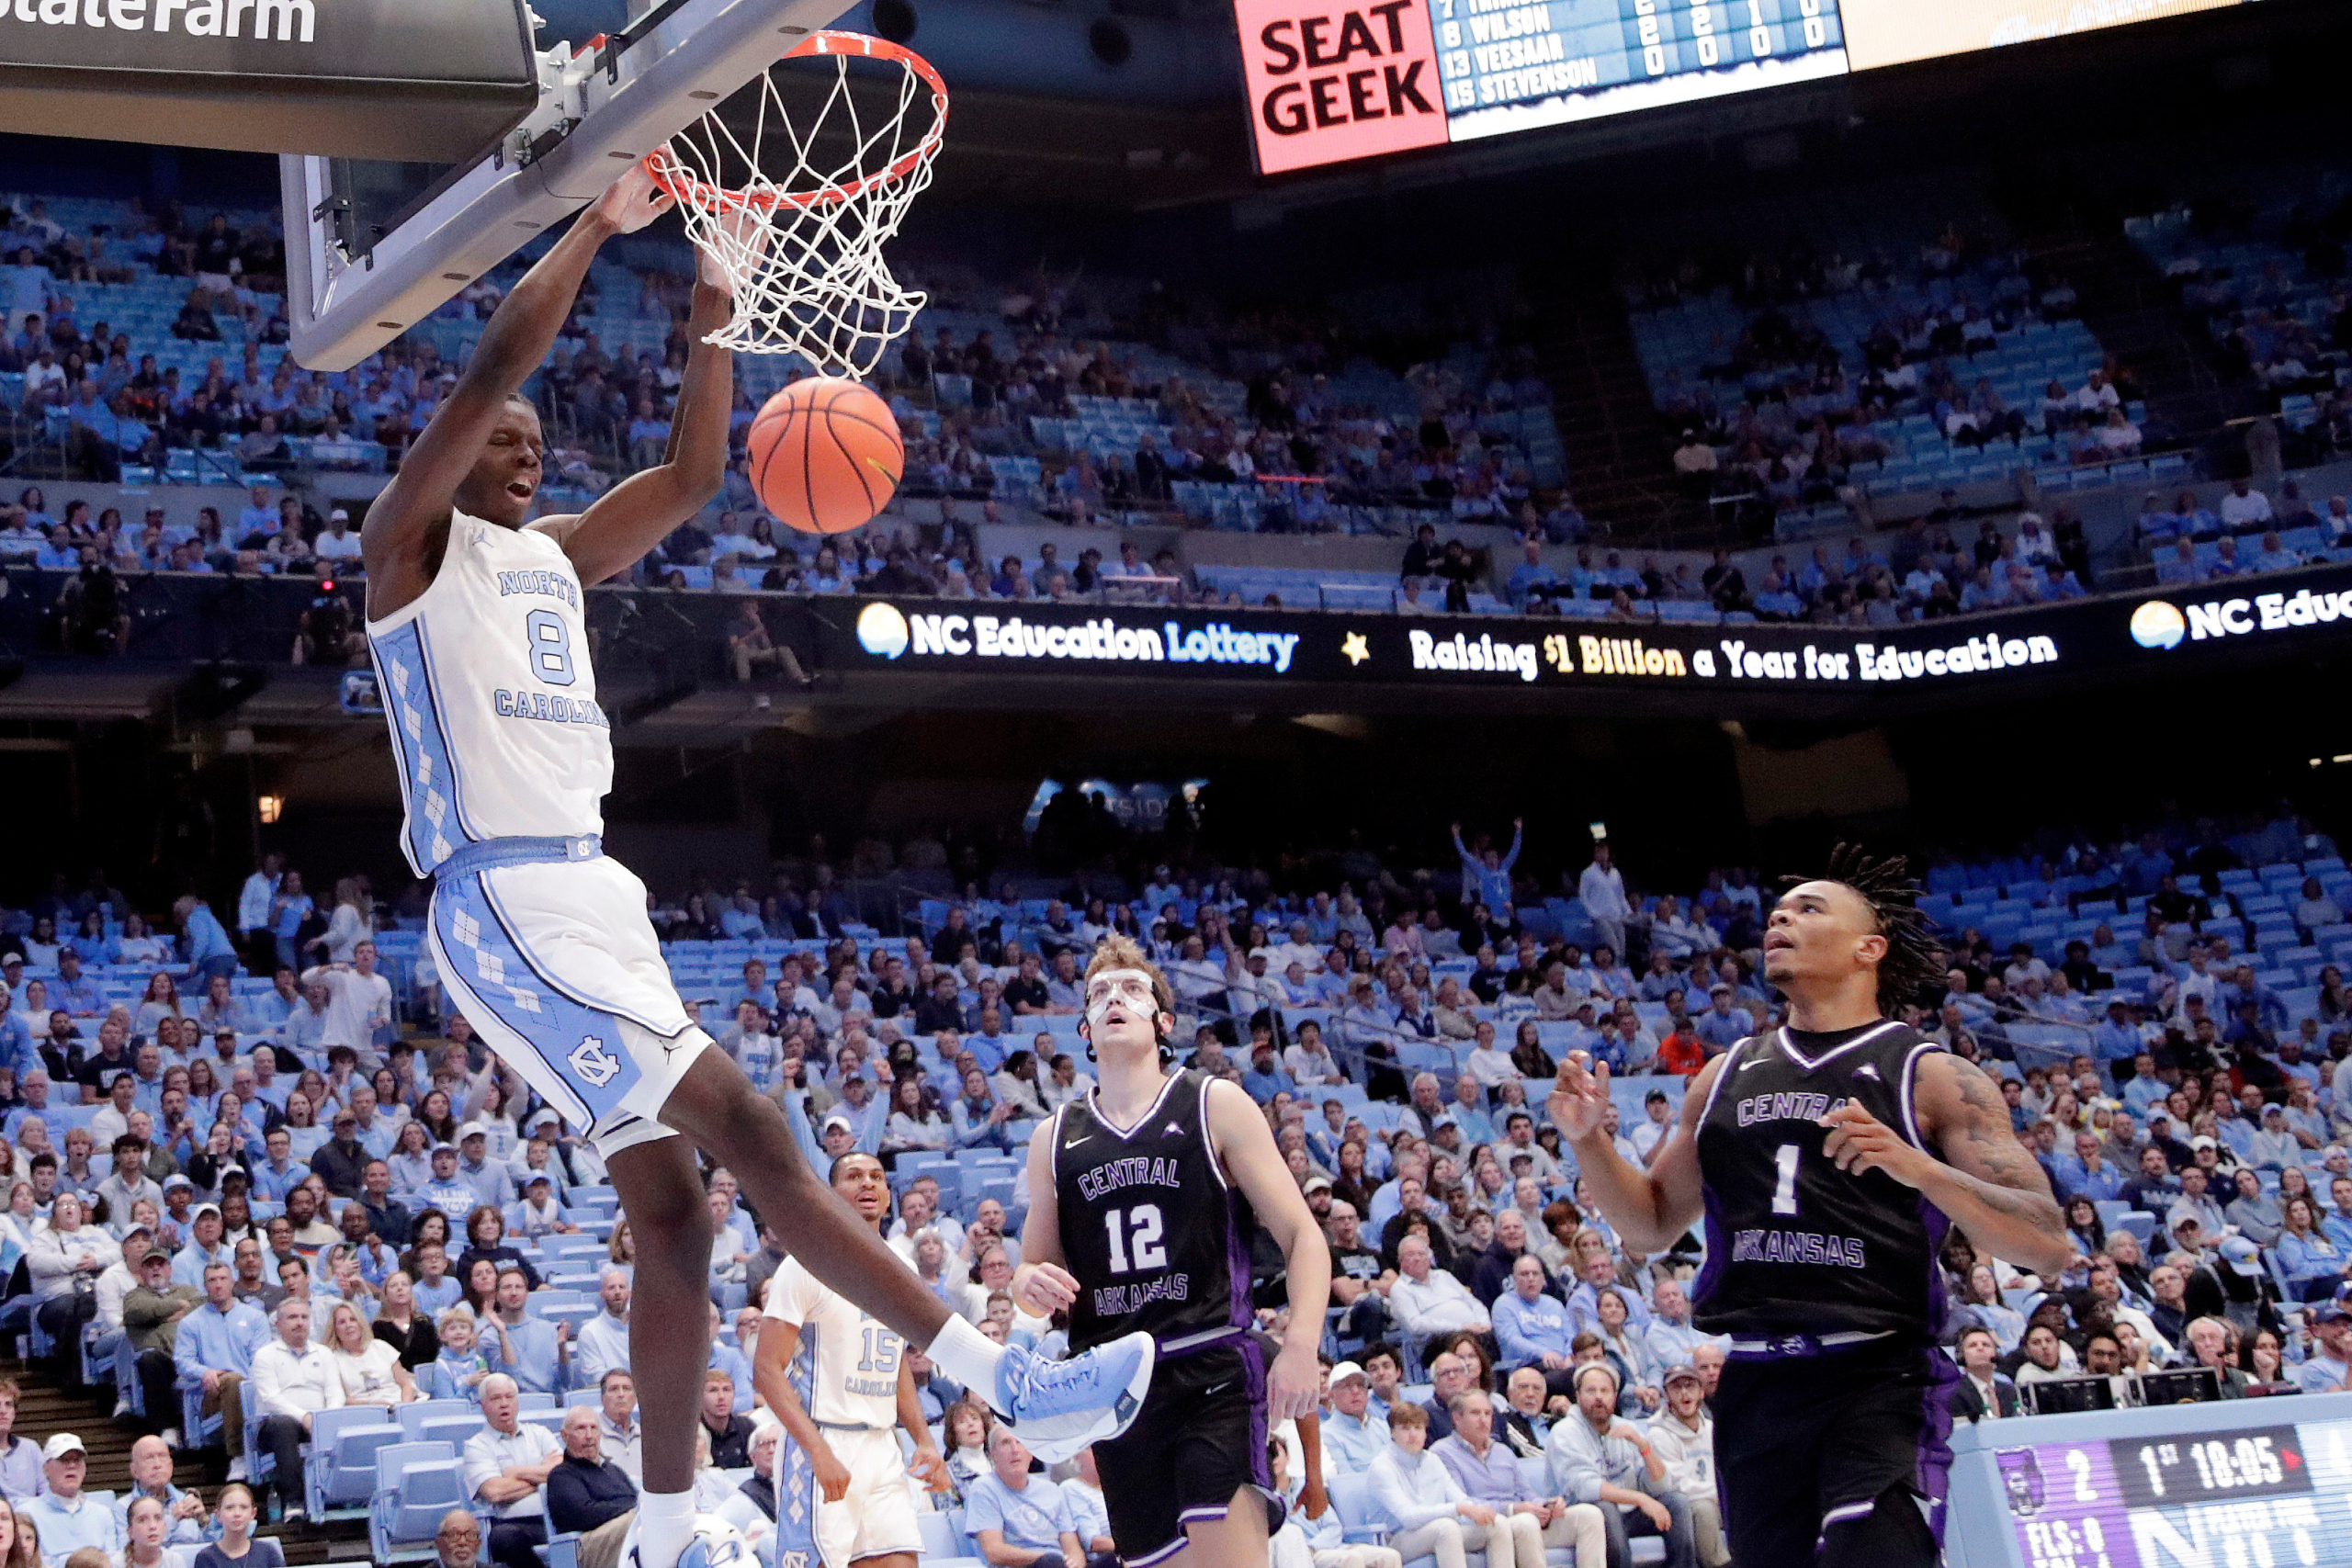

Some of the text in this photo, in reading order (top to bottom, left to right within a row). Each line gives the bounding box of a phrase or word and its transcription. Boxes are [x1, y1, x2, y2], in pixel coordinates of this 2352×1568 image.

[1261, 0, 1413, 75] SEAT
[1442, 20, 1462, 48] 8
[1470, 4, 1551, 44] WILSON
[1443, 50, 1471, 79] 13
[1474, 32, 1565, 73] VEESAAR
[1638, 15, 1660, 46] 2
[1690, 5, 1713, 37] 2
[1448, 16, 1826, 108] 15 STEVENSON 0 0 0 0
[1262, 60, 1438, 136] GEEK
[497, 570, 579, 610] NORTH
[2185, 598, 2256, 640] NC
[526, 608, 576, 686] 8
[909, 614, 1300, 673] NC Education Lottery
[1409, 629, 2058, 682] Raising $1 Billion a Year for Education
[1078, 1156, 1181, 1202] CENTRAL
[1771, 1144, 1801, 1214] 1
[1104, 1203, 1168, 1273] 12
[1732, 1229, 1866, 1269] ARKANSAS
[857, 1328, 900, 1372] 15
[2065, 1449, 2098, 1501] 2
[2190, 1436, 2284, 1490] 18:05
